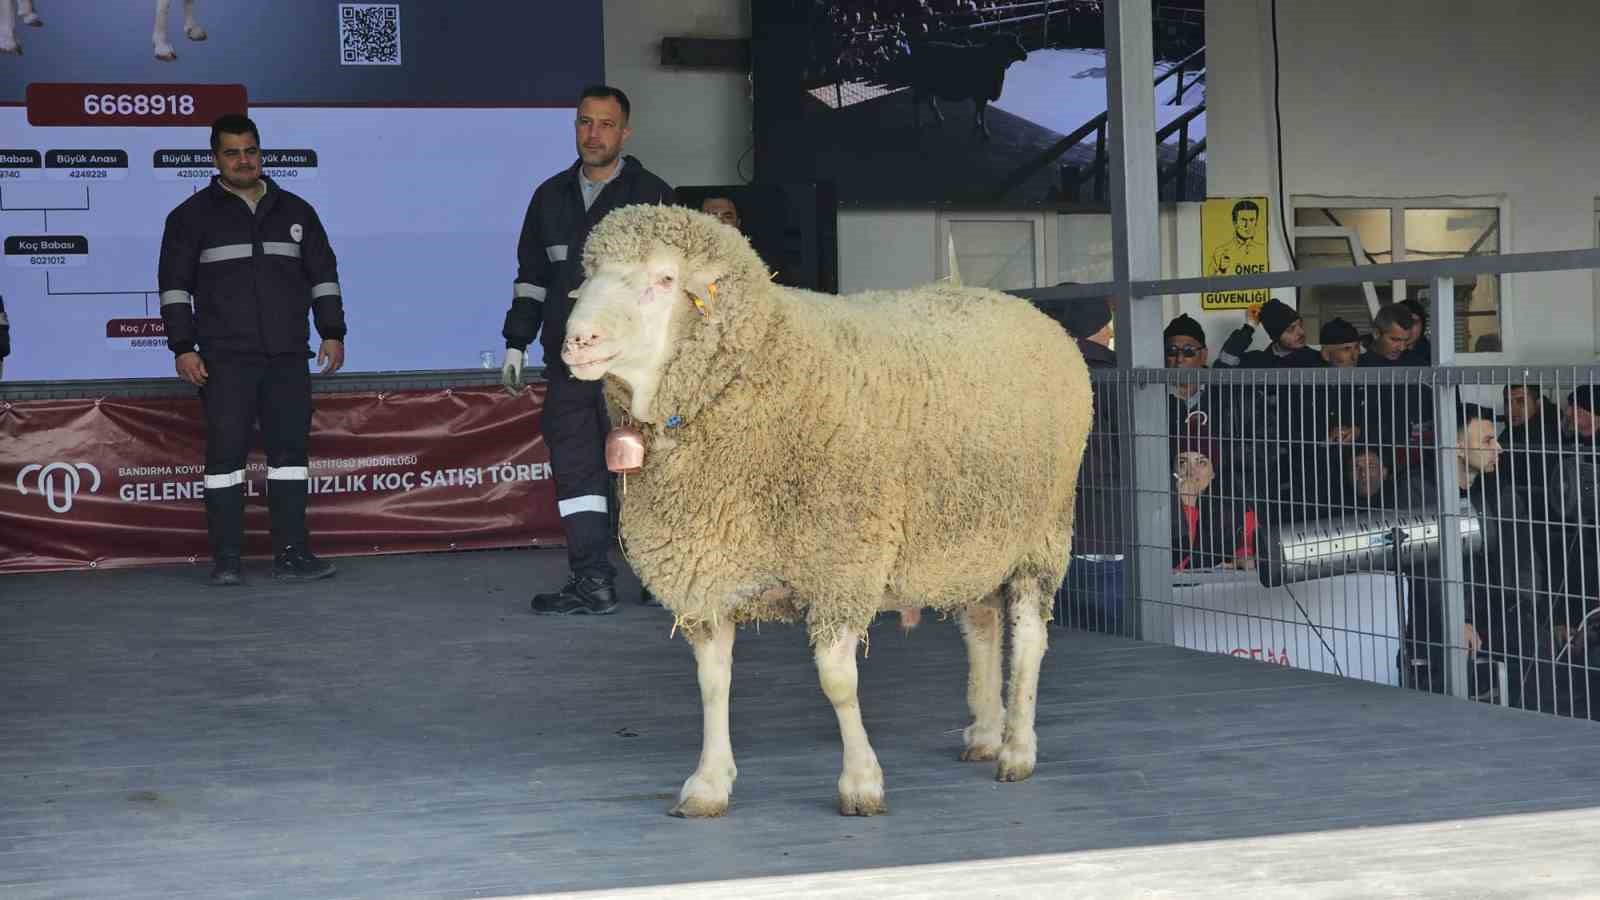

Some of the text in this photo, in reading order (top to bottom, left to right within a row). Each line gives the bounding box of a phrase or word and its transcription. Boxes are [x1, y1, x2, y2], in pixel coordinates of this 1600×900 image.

[83, 94, 194, 115] 6668918
[56, 154, 117, 165] Büyük Anası
[162, 154, 192, 165] Büyük
[280, 154, 307, 163] Anası
[19, 241, 75, 251] Koç Babası
[120, 324, 139, 334] Koç
[118, 465, 172, 477] BANDIRMA
[372, 471, 416, 493] KOÇ
[420, 467, 483, 488] SATIŞI
